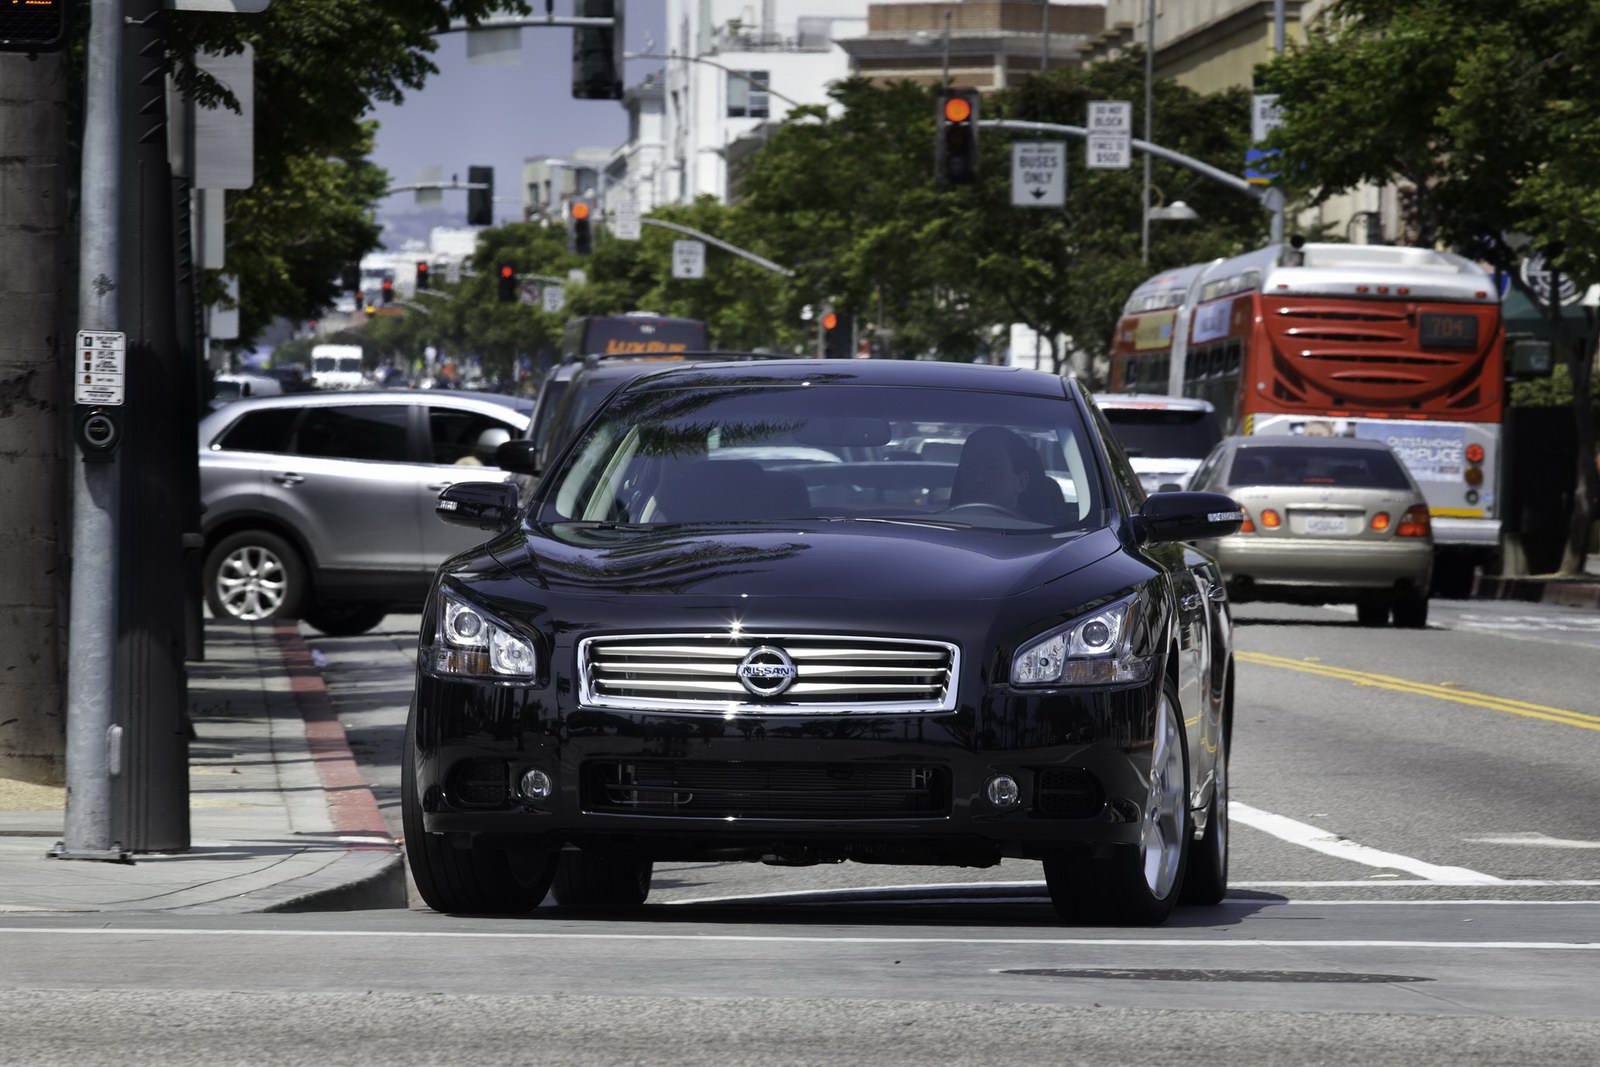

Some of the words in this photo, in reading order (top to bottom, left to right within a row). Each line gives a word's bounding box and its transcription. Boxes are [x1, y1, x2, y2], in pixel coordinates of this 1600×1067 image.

[1260, 106, 1283, 119] BUS
[1095, 117, 1122, 127] BLOCK
[1019, 155, 1057, 169] BUSES
[1096, 152, 1120, 163] $500
[1023, 171, 1053, 185] ONLY
[1431, 317, 1464, 337] 704
[1387, 435, 1463, 449] OUTSTANDING
[1392, 447, 1461, 463] OMPLICE
[742, 667, 790, 675] NISSAN
